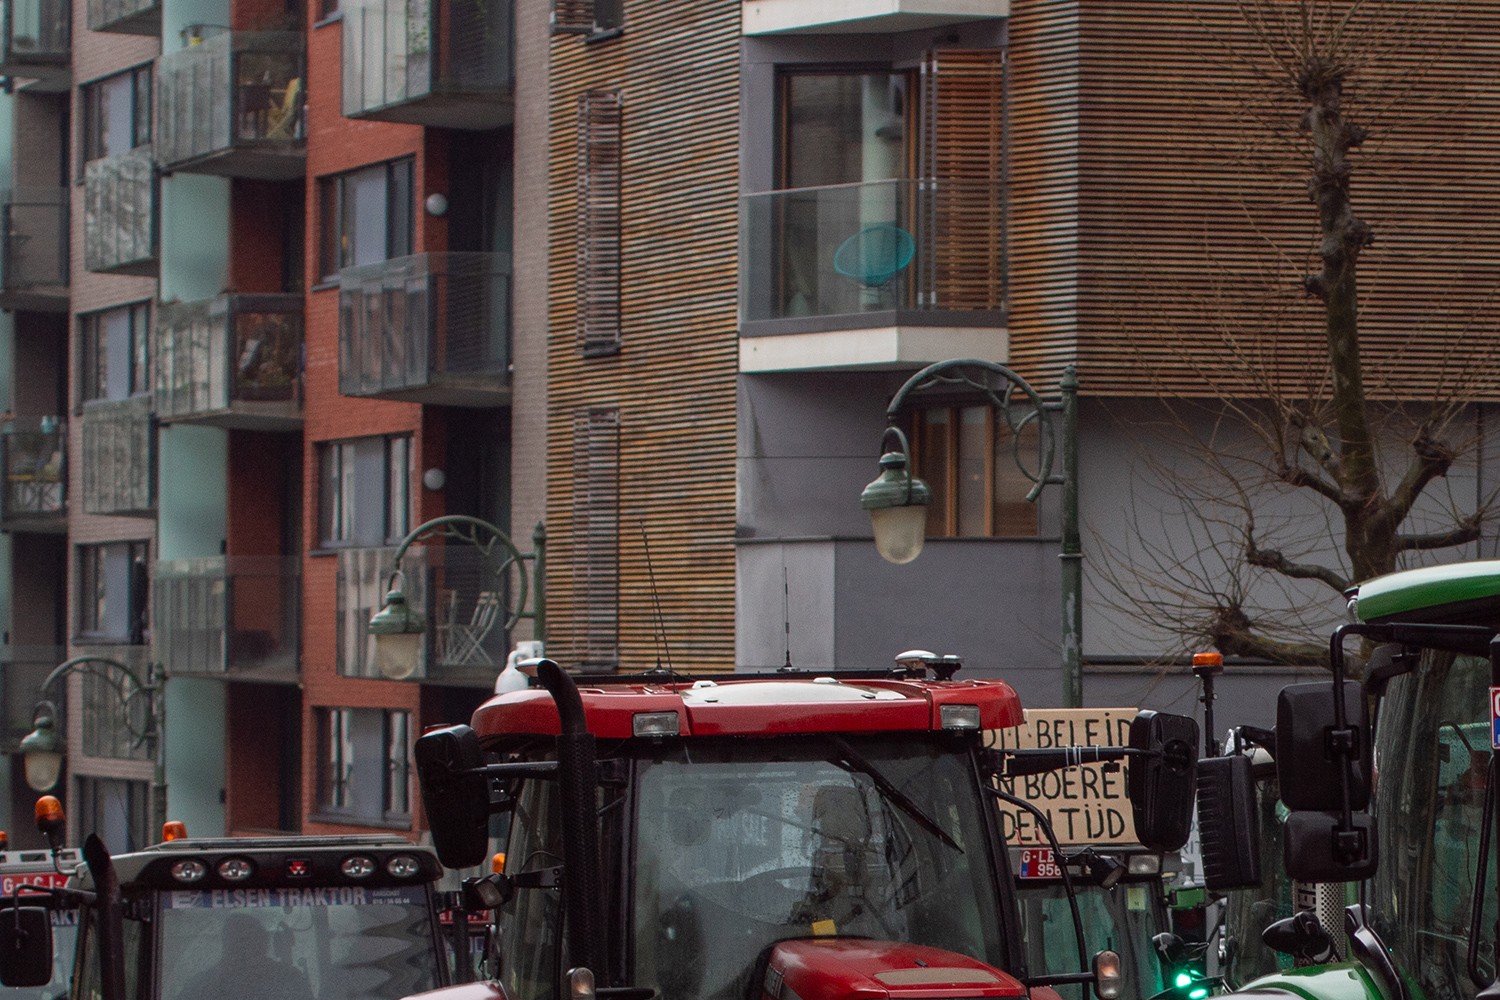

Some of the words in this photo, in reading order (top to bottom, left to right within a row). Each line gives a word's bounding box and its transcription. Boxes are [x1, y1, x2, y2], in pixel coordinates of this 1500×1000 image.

[1024, 766, 1130, 799] BOERE
[211, 888, 271, 908] ELSEN
[278, 886, 368, 907] TRAKTOR
